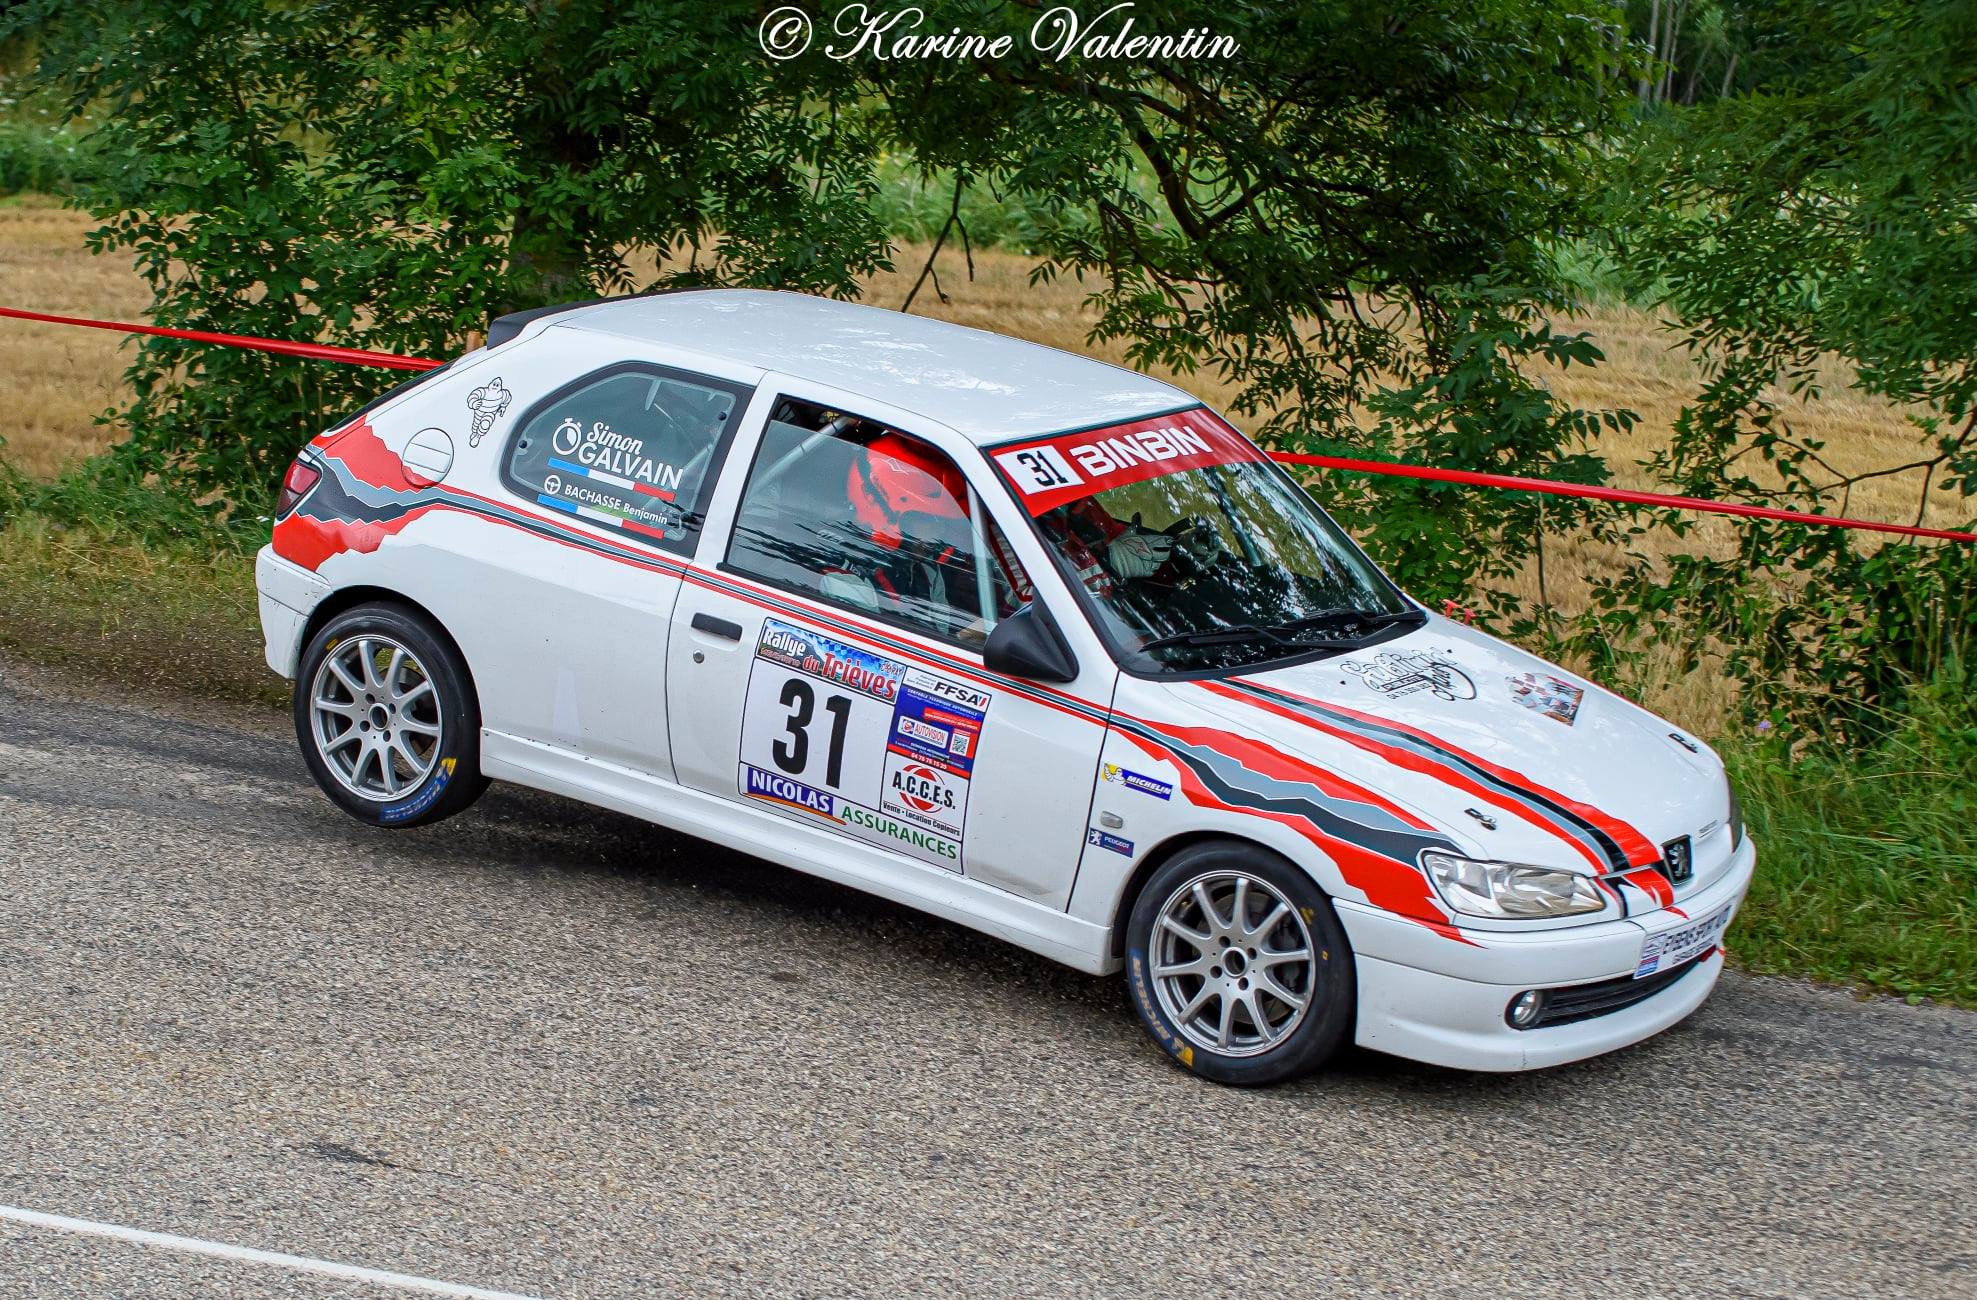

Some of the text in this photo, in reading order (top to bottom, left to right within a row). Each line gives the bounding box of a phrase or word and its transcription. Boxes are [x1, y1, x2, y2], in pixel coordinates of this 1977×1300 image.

[586, 422, 643, 455] Simon
[1016, 426, 1213, 487] 31 BINBIN
[578, 442, 684, 490] GALVAIN
[565, 485, 668, 525] BACHASSE Benjamin
[763, 627, 806, 657] Rallye
[802, 655, 819, 673] du
[821, 652, 897, 700] Trièves
[933, 681, 979, 706] FFSA
[772, 678, 853, 789] 31
[915, 723, 946, 742] AUTOVISION
[751, 768, 831, 814] NICOLAS
[892, 771, 956, 810] A.C.C.E.S.
[1126, 775, 1172, 795] MICHELIN
[841, 805, 957, 860] ASSURANCES
[883, 802, 960, 836] Vente Location Copieurs
[1104, 836, 1130, 849] PEUGEOT
